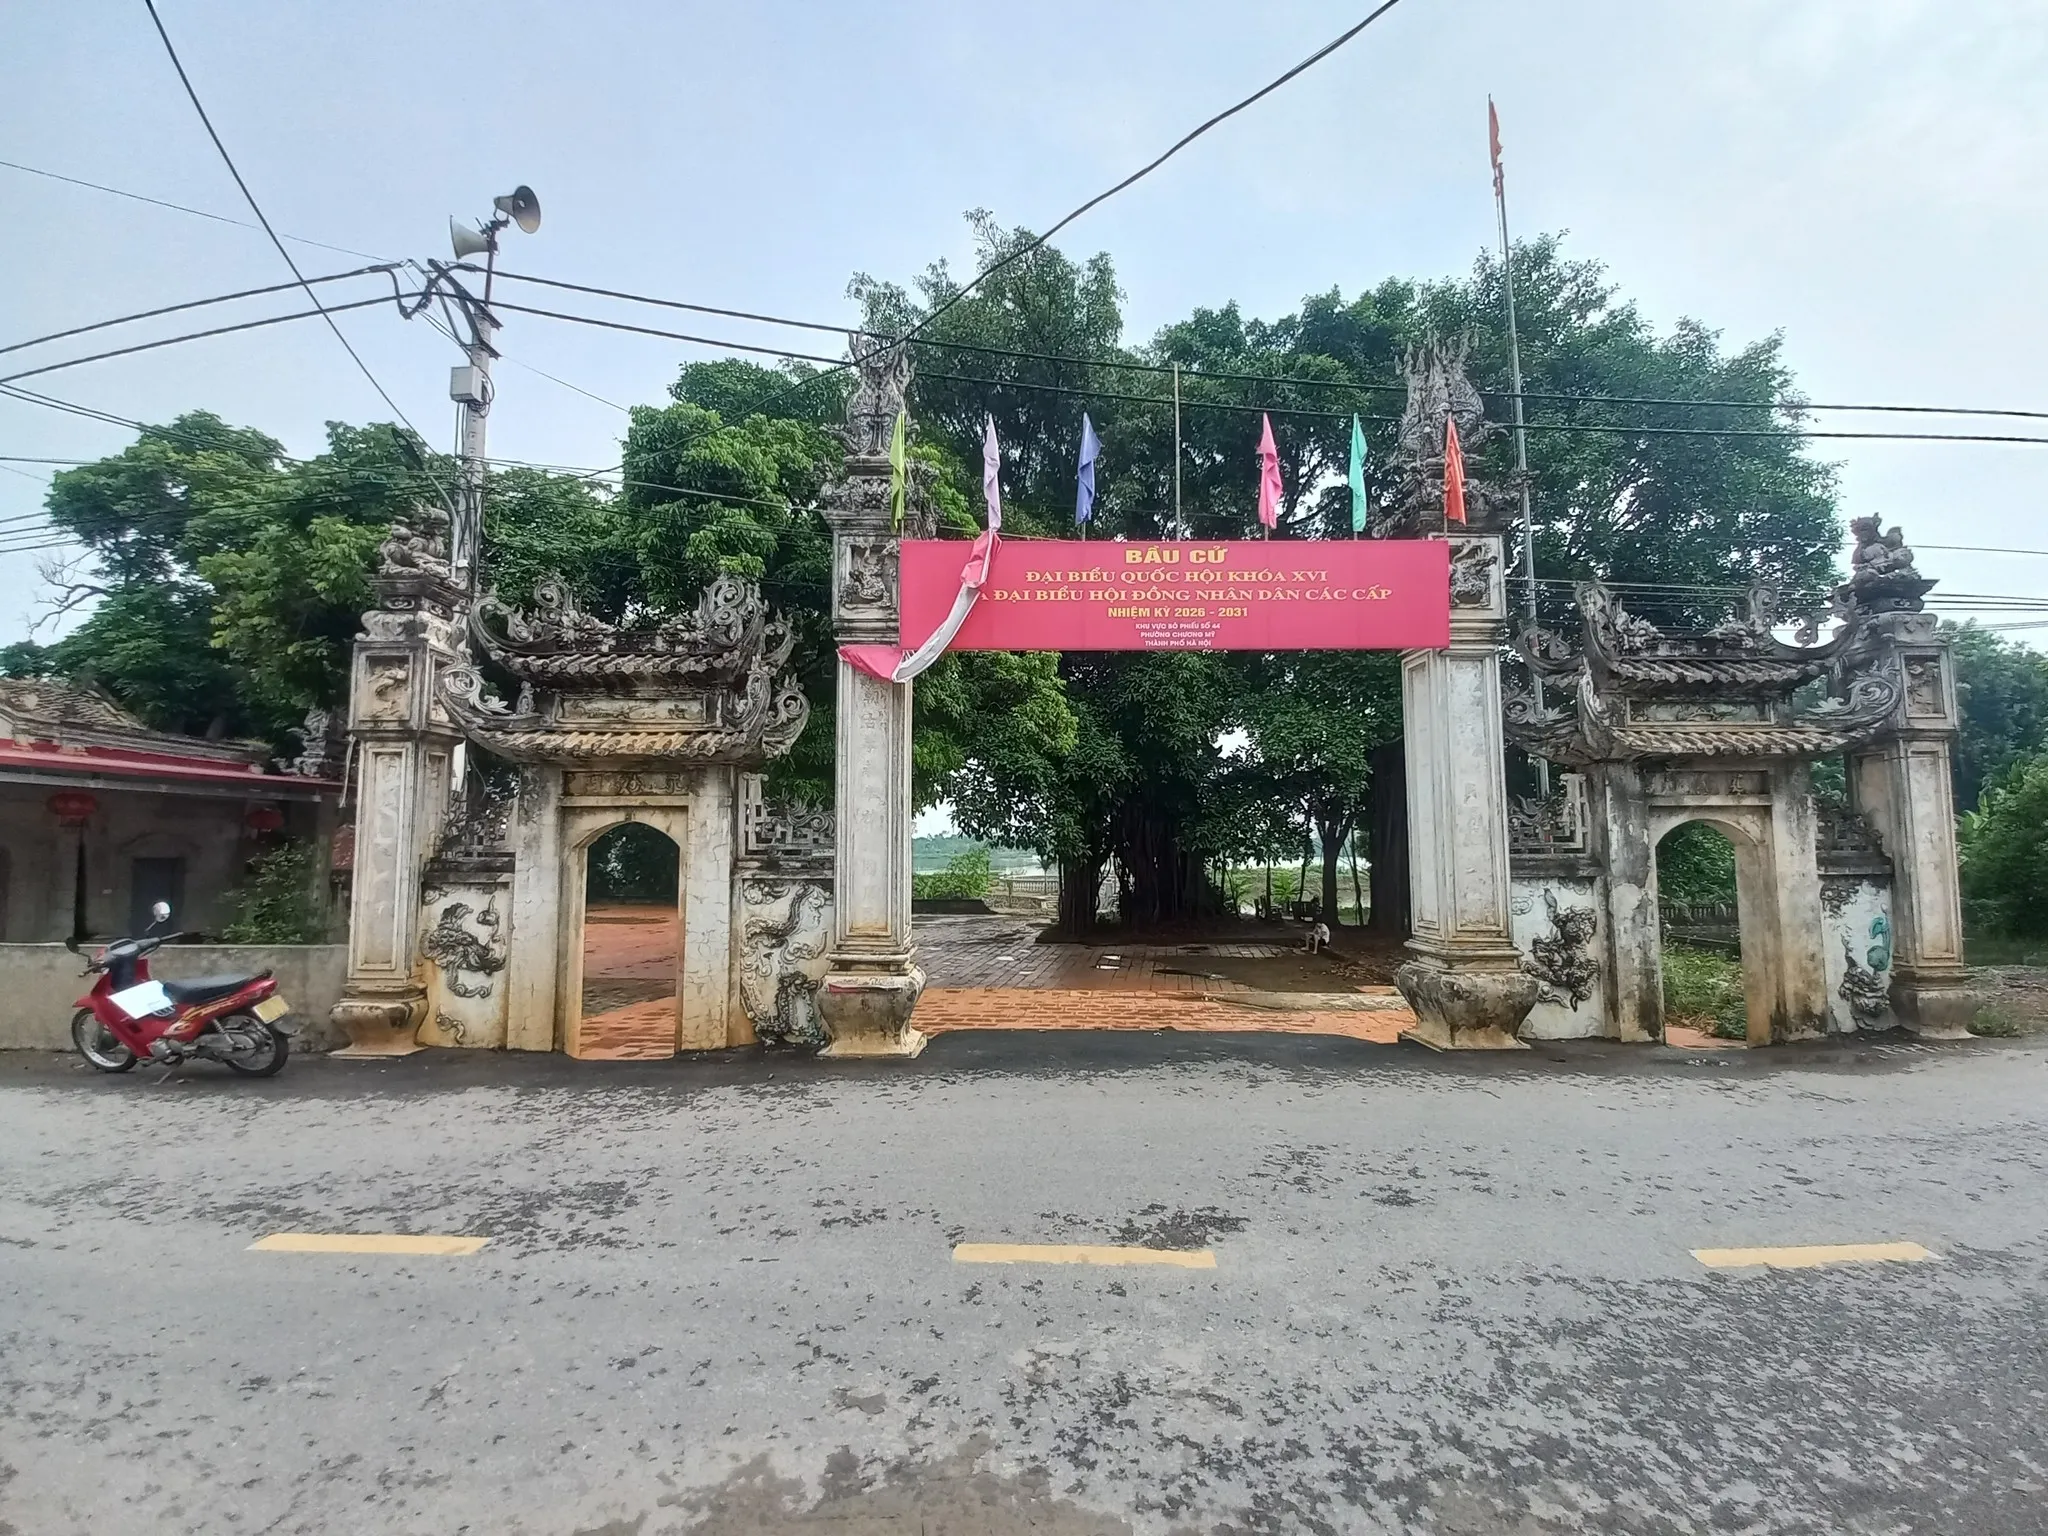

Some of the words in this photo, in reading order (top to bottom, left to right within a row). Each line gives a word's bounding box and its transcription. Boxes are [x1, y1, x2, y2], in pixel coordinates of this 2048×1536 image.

[1125, 545, 1180, 564] BẦU
[1189, 545, 1229, 564] CỬ
[1026, 571, 1063, 584] ĐẠI
[1068, 567, 1115, 582] BIỂU
[1121, 567, 1180, 584] QUỐC
[1185, 569, 1223, 584] HỘI
[1228, 569, 1286, 582] KHÓA
[1292, 571, 1328, 582] XVI
[994, 589, 1030, 603] ĐẠI
[1035, 585, 1083, 601] BIỂU
[1089, 588, 1127, 603] HỘI
[1132, 583, 1190, 601] ĐỒNG
[1196, 588, 1253, 600] NHÂN
[1258, 588, 1300, 600] DÂN
[1305, 588, 1346, 600] CÁC
[1352, 584, 1392, 600] CẤP
[1108, 606, 1150, 619] NHIỆM
[1174, 607, 1206, 617] 2026
[1218, 607, 1248, 617] 2031
[1145, 638, 1169, 646] THÀNH
[1198, 639, 1211, 647] NỘI
